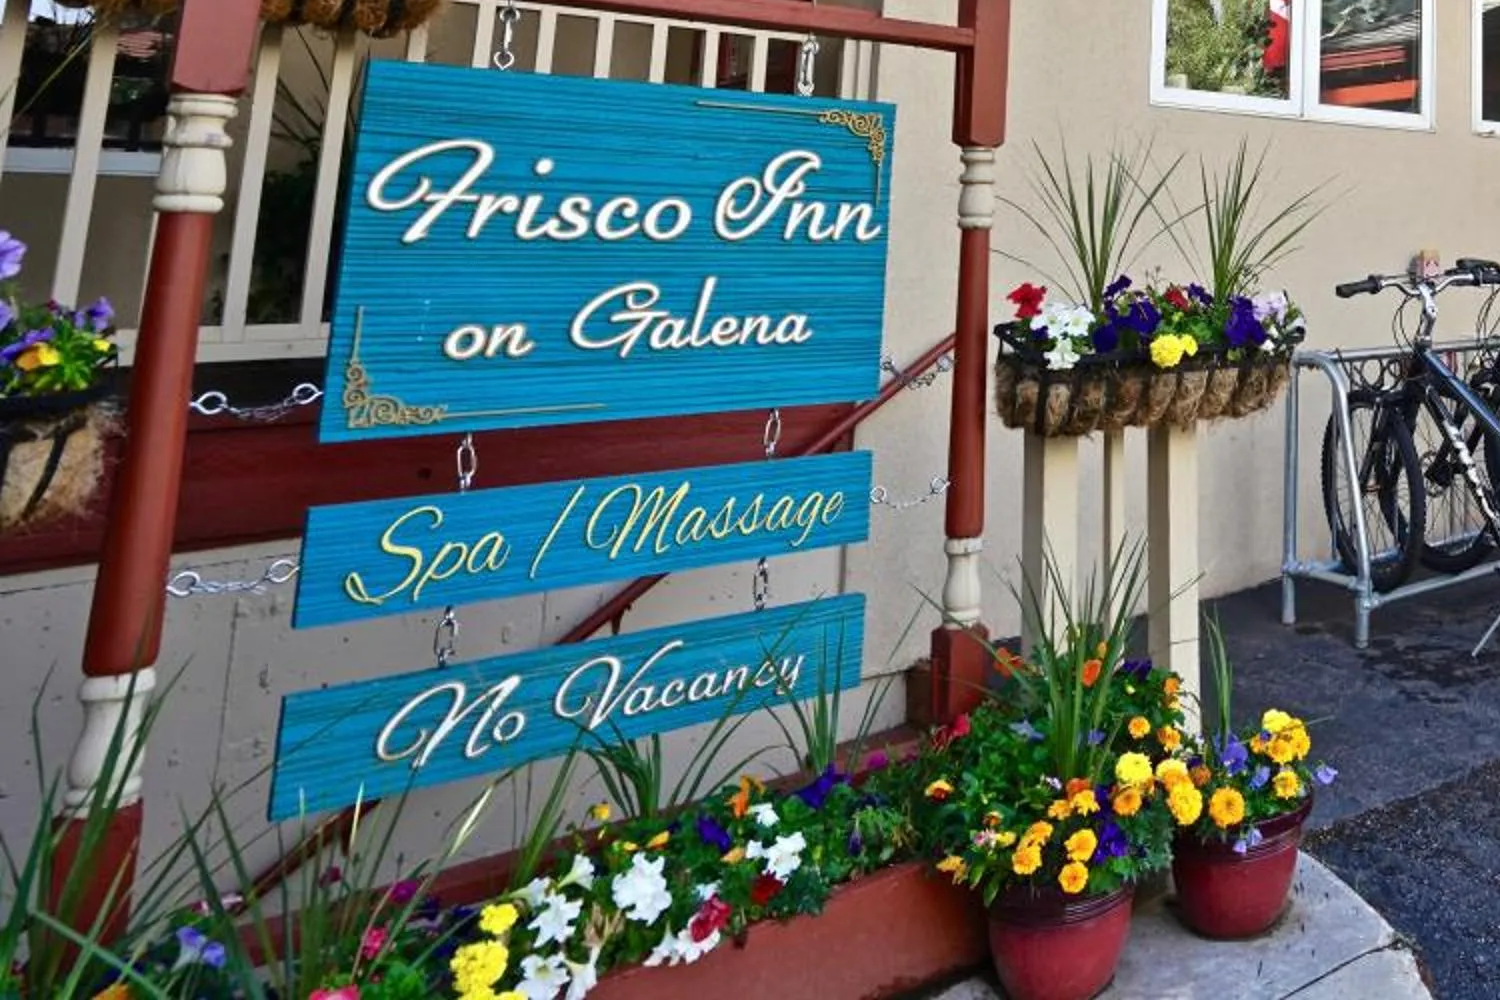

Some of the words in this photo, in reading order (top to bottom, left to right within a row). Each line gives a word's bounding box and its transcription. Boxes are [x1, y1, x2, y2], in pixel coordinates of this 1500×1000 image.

[366, 139, 692, 243] Frisco
[714, 150, 881, 242] Inn
[442, 322, 534, 359] on
[570, 277, 812, 358] Galena
[345, 504, 510, 605] Spa
[585, 480, 844, 560] Massage
[375, 675, 527, 769] No
[554, 639, 806, 731] Vacancy
